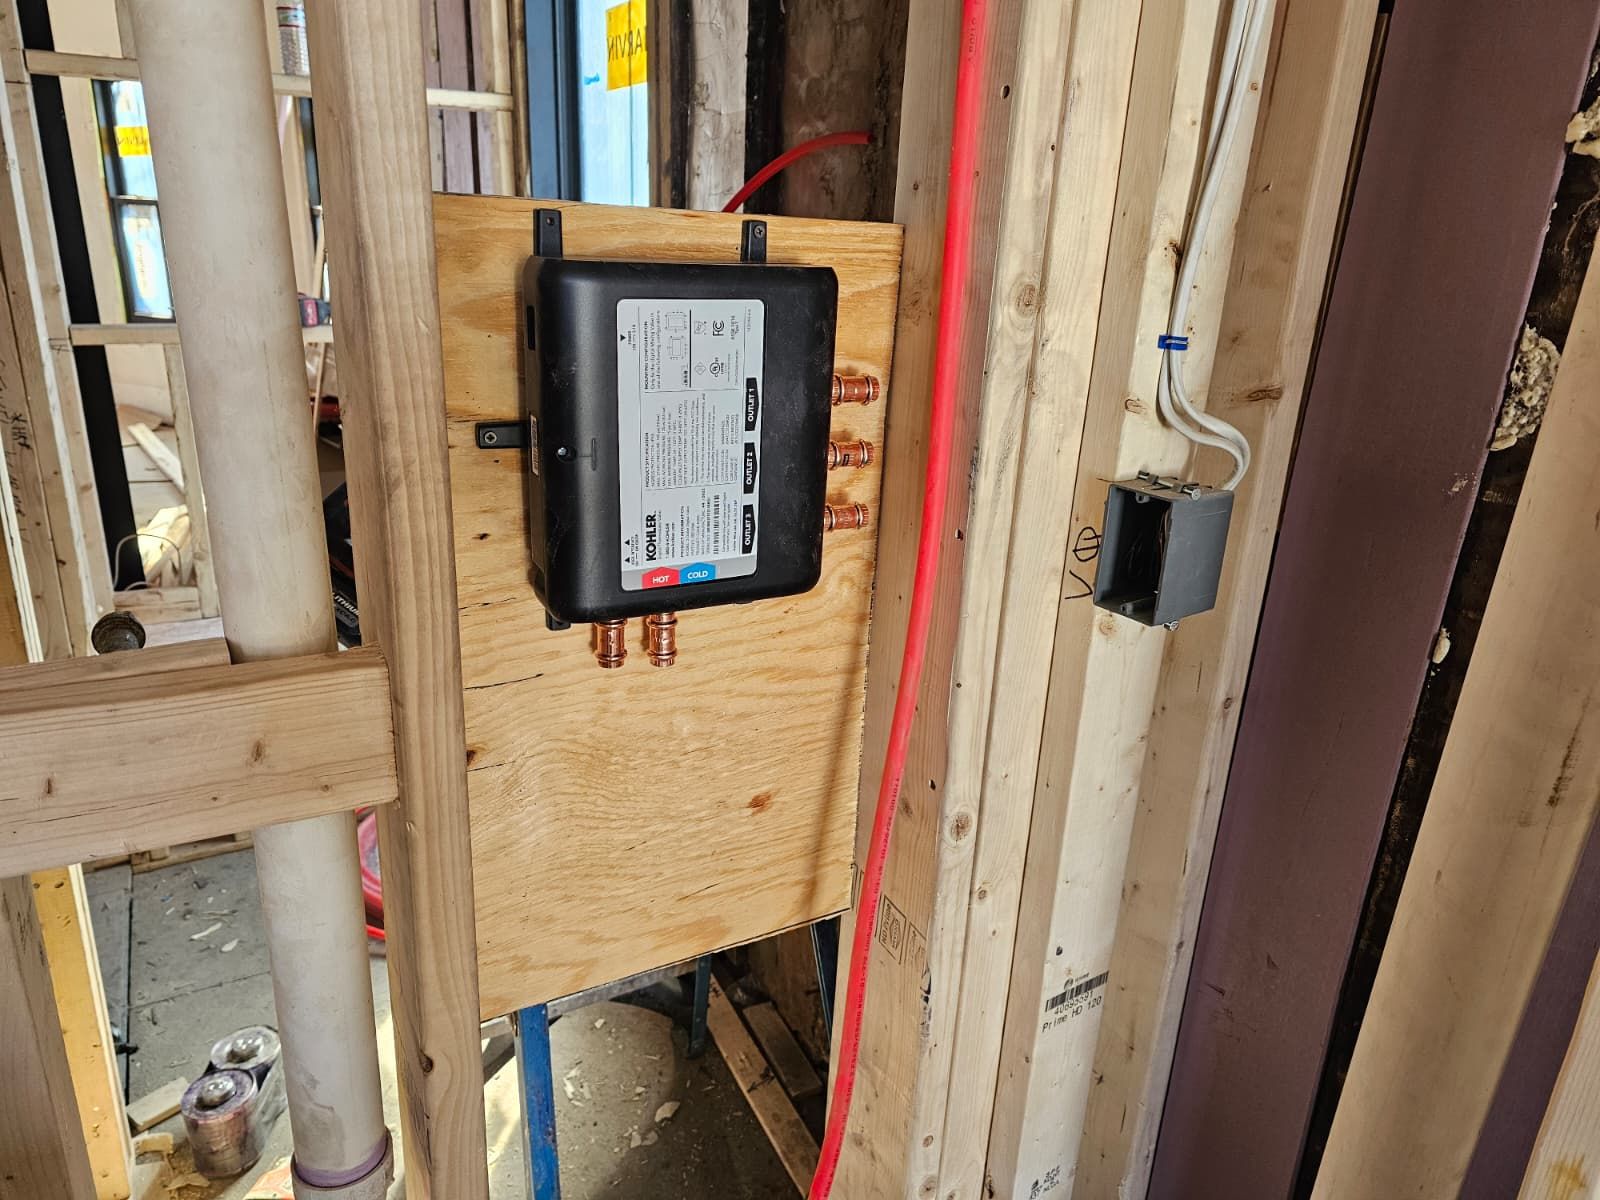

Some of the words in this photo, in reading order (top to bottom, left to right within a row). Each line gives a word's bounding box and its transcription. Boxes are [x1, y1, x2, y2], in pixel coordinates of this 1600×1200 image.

[646, 514, 656, 561] KOHLER
[651, 575, 670, 584] HOT
[688, 570, 708, 580] COLD
[1088, 996, 1102, 1010] 120
